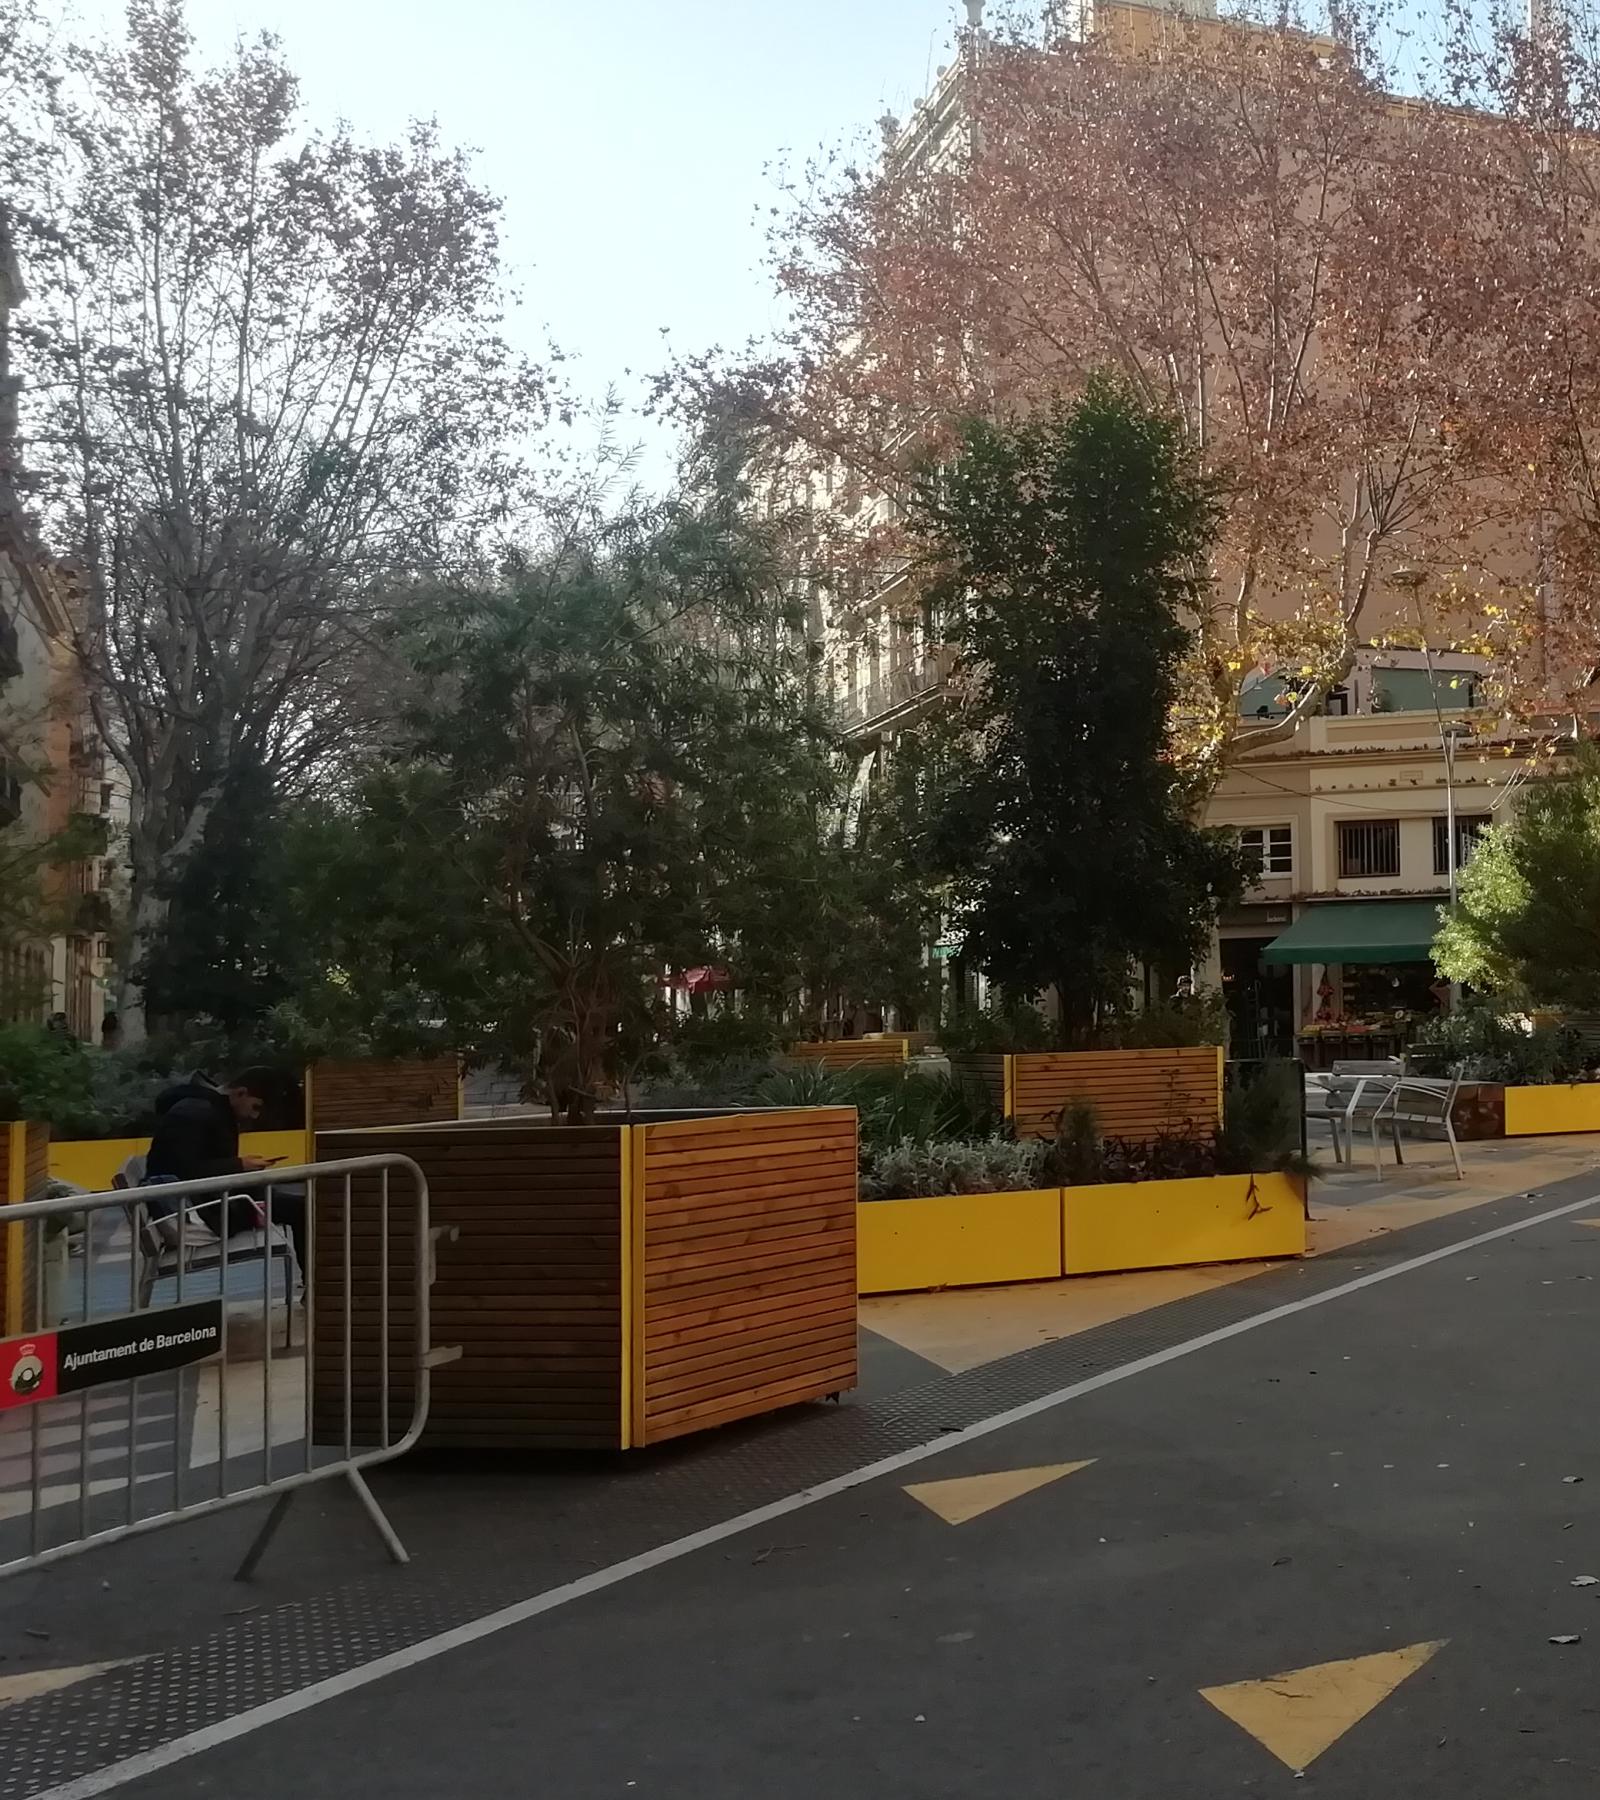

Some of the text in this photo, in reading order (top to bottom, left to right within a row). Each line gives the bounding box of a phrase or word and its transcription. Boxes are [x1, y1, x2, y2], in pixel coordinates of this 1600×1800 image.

[63, 1326, 217, 1370] Ajuntament de Barcelona
